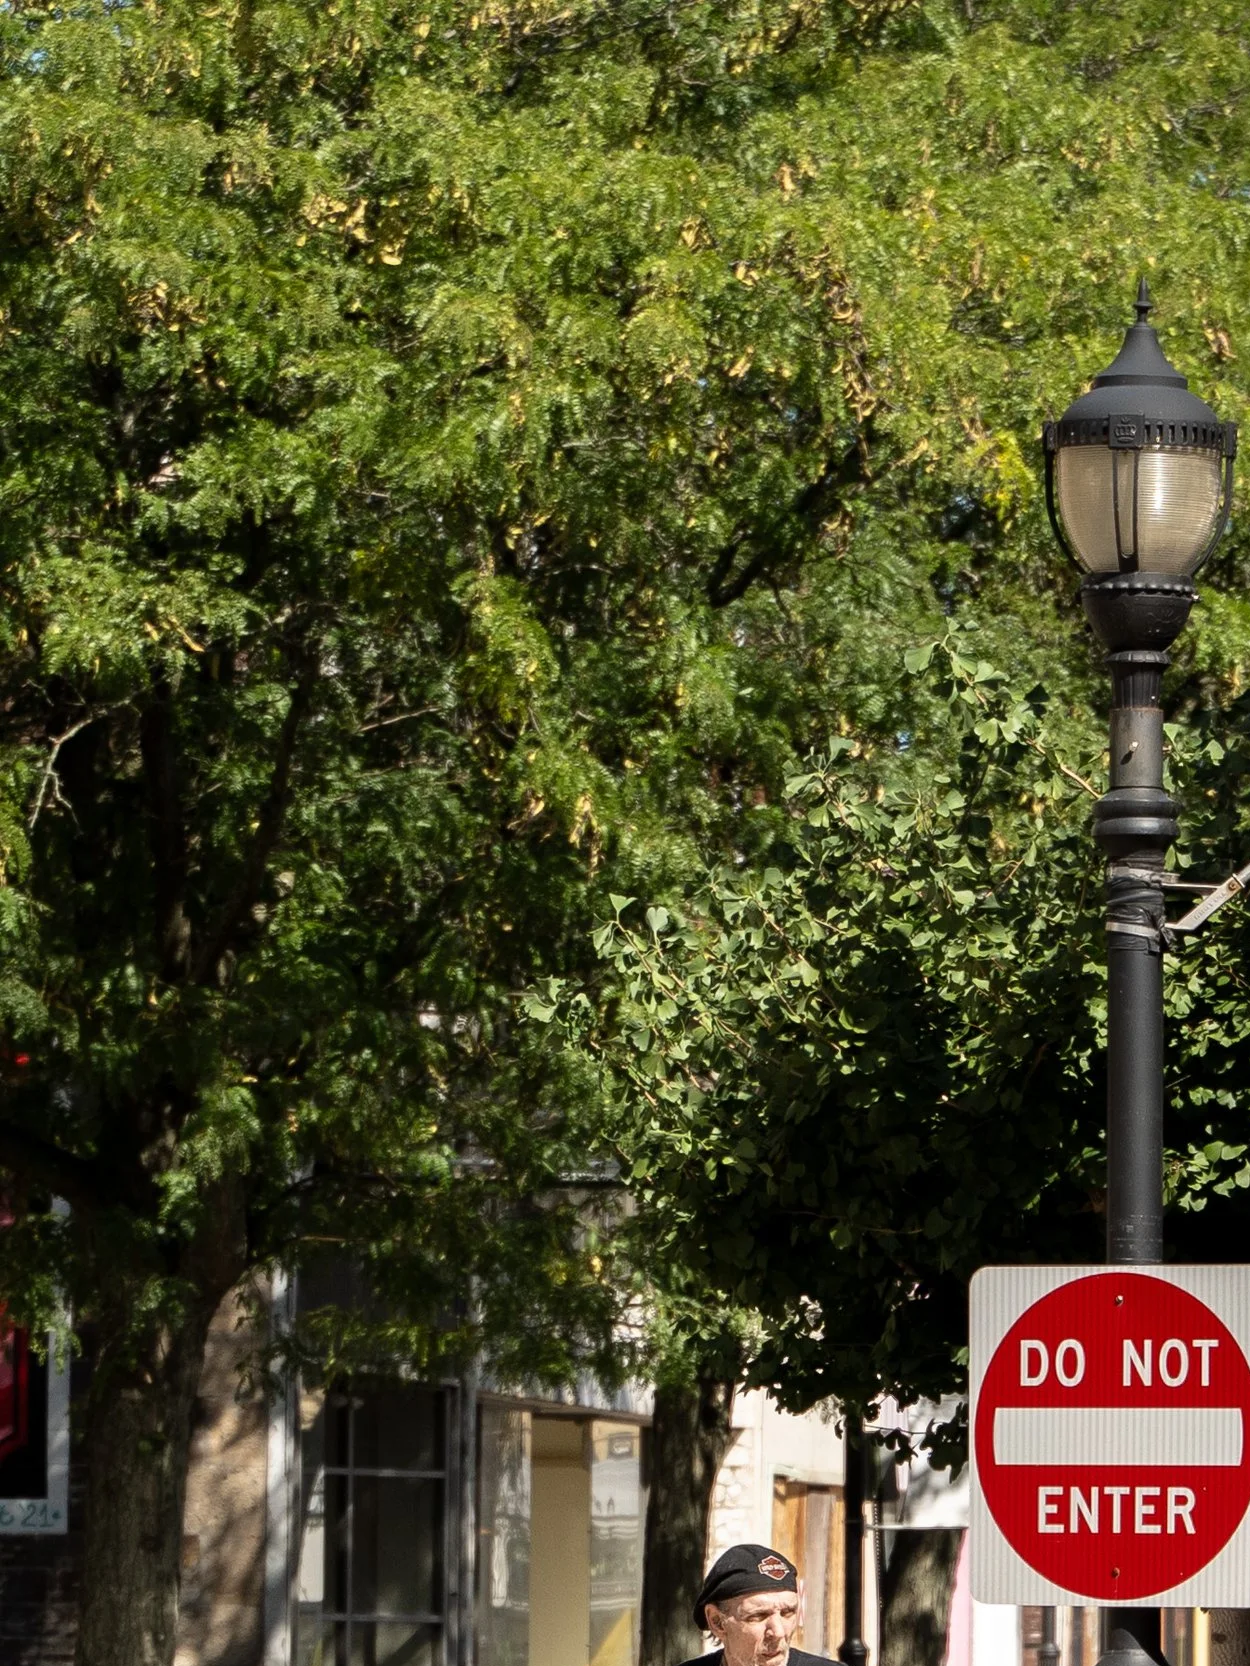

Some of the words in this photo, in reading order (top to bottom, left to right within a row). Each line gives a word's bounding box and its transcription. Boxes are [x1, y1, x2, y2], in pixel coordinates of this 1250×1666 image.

[1019, 1338, 1086, 1388] DO
[1122, 1338, 1219, 1388] NOT
[1037, 1485, 1197, 1535] ENTER
